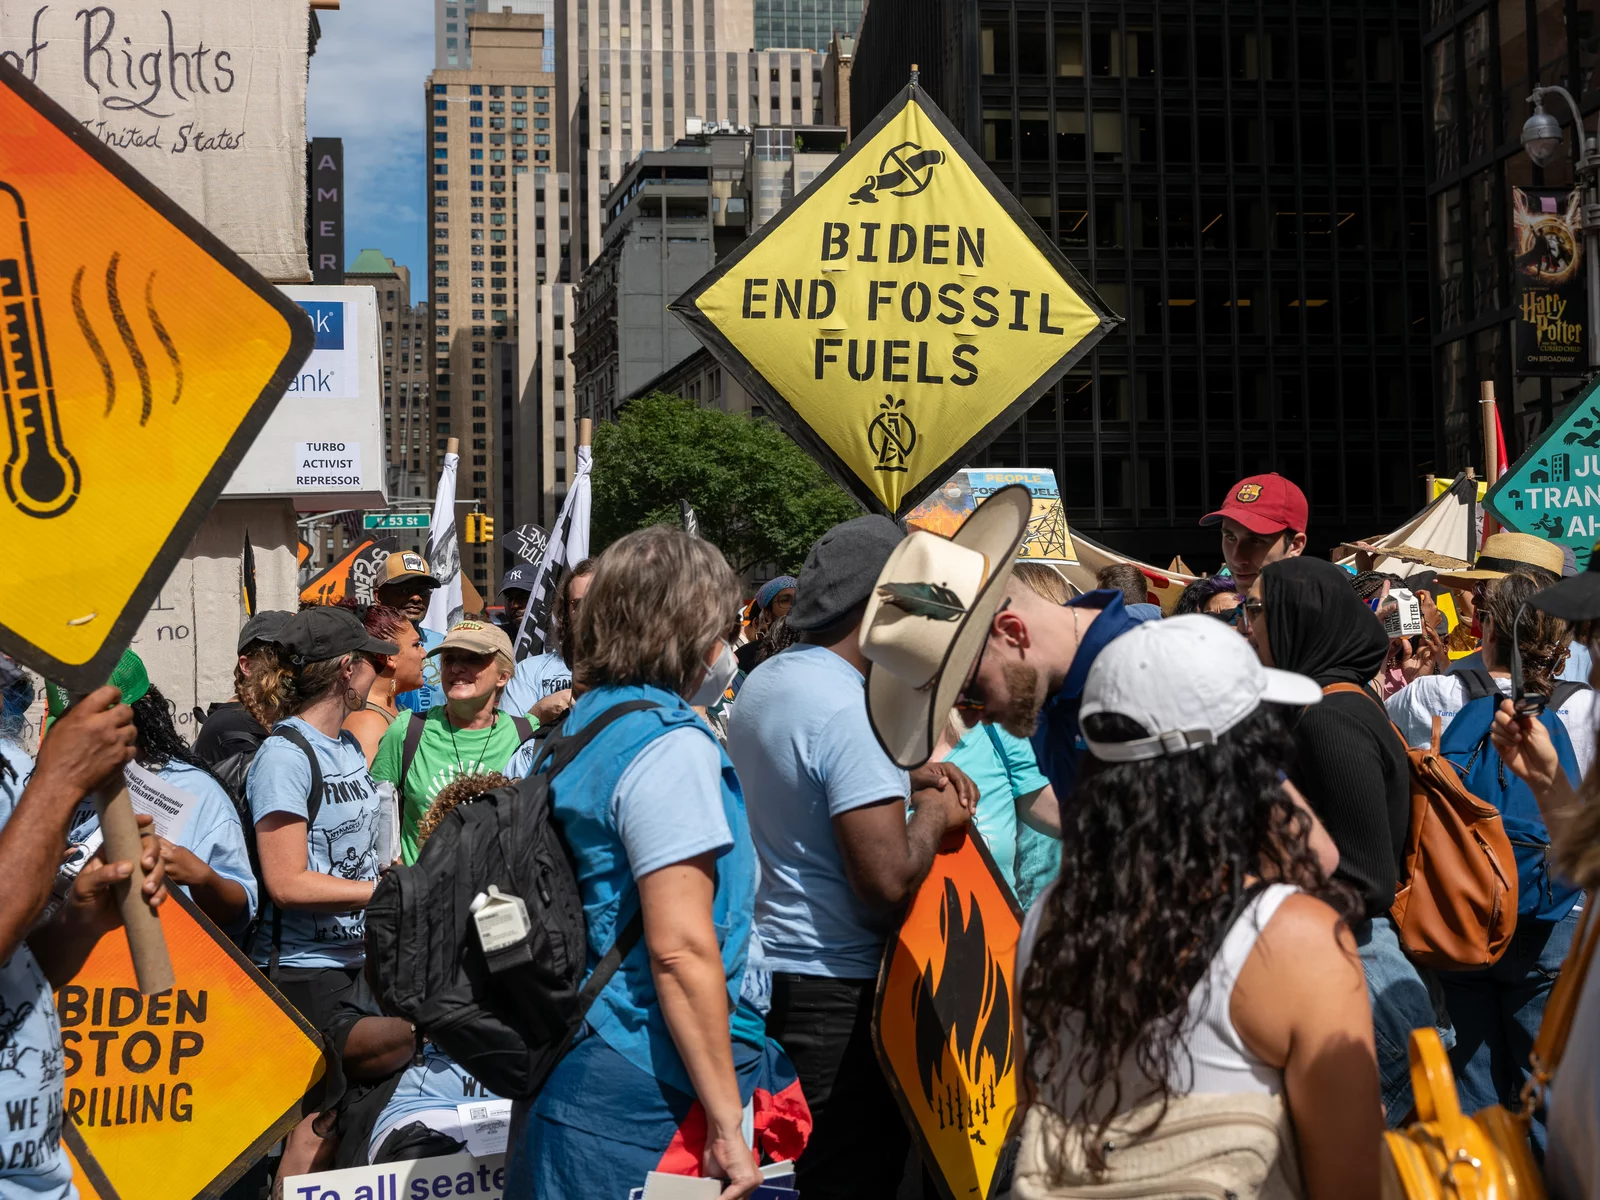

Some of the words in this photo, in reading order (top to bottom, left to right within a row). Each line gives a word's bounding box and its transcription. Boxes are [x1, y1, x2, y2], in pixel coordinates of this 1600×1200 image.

[75, 6, 235, 118] Rights
[171, 122, 246, 154] States
[820, 221, 985, 268] BIDEN
[741, 278, 837, 320] END
[867, 279, 1065, 335] FOSSIL
[1519, 292, 1567, 323] Harry
[1536, 315, 1583, 348] Potter
[814, 337, 980, 386] FUELS
[1527, 355, 1538, 363] ON
[1539, 355, 1576, 363] BROADWAY
[306, 442, 346, 452] TURBO
[302, 459, 353, 469] ACTIVIST
[985, 473, 1042, 484] PEOPLE
[296, 475, 360, 485] REPRESSOR
[389, 517, 403, 526] 53
[406, 517, 419, 526] St
[1403, 623, 1412, 631] IS
[153, 797, 180, 816] Change
[57, 985, 208, 1027] BIDEN
[63, 1030, 205, 1079] STOP
[6, 1096, 39, 1132] WE
